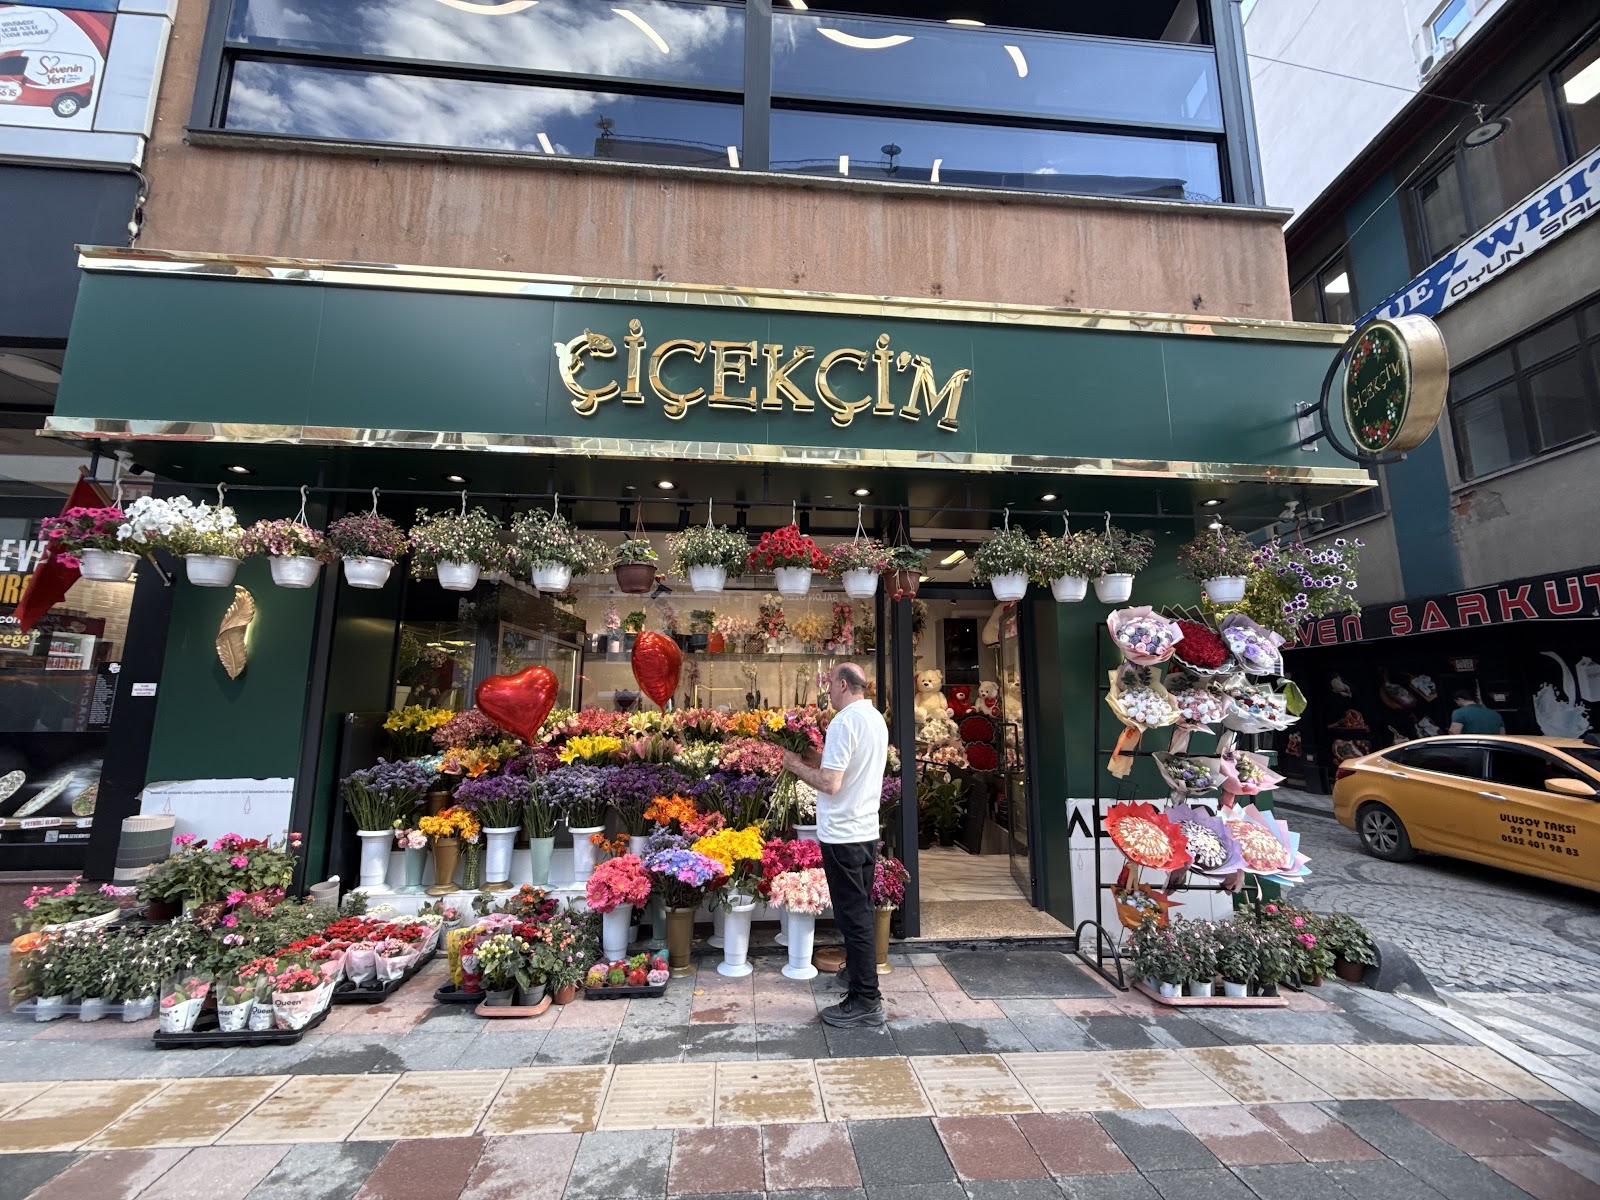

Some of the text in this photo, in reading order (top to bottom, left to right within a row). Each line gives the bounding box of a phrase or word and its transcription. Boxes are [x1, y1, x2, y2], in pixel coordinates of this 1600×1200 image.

[37, 55, 83, 76] Sevenin
[47, 75, 66, 85] Yeri
[1450, 243, 1524, 298] OYUN
[1500, 813, 1540, 828] ULUSOY
[1510, 826, 1565, 843] 29 T 0033
[1501, 834, 1579, 857] 0532 401 98 83
[275, 999, 302, 1008] Queen
